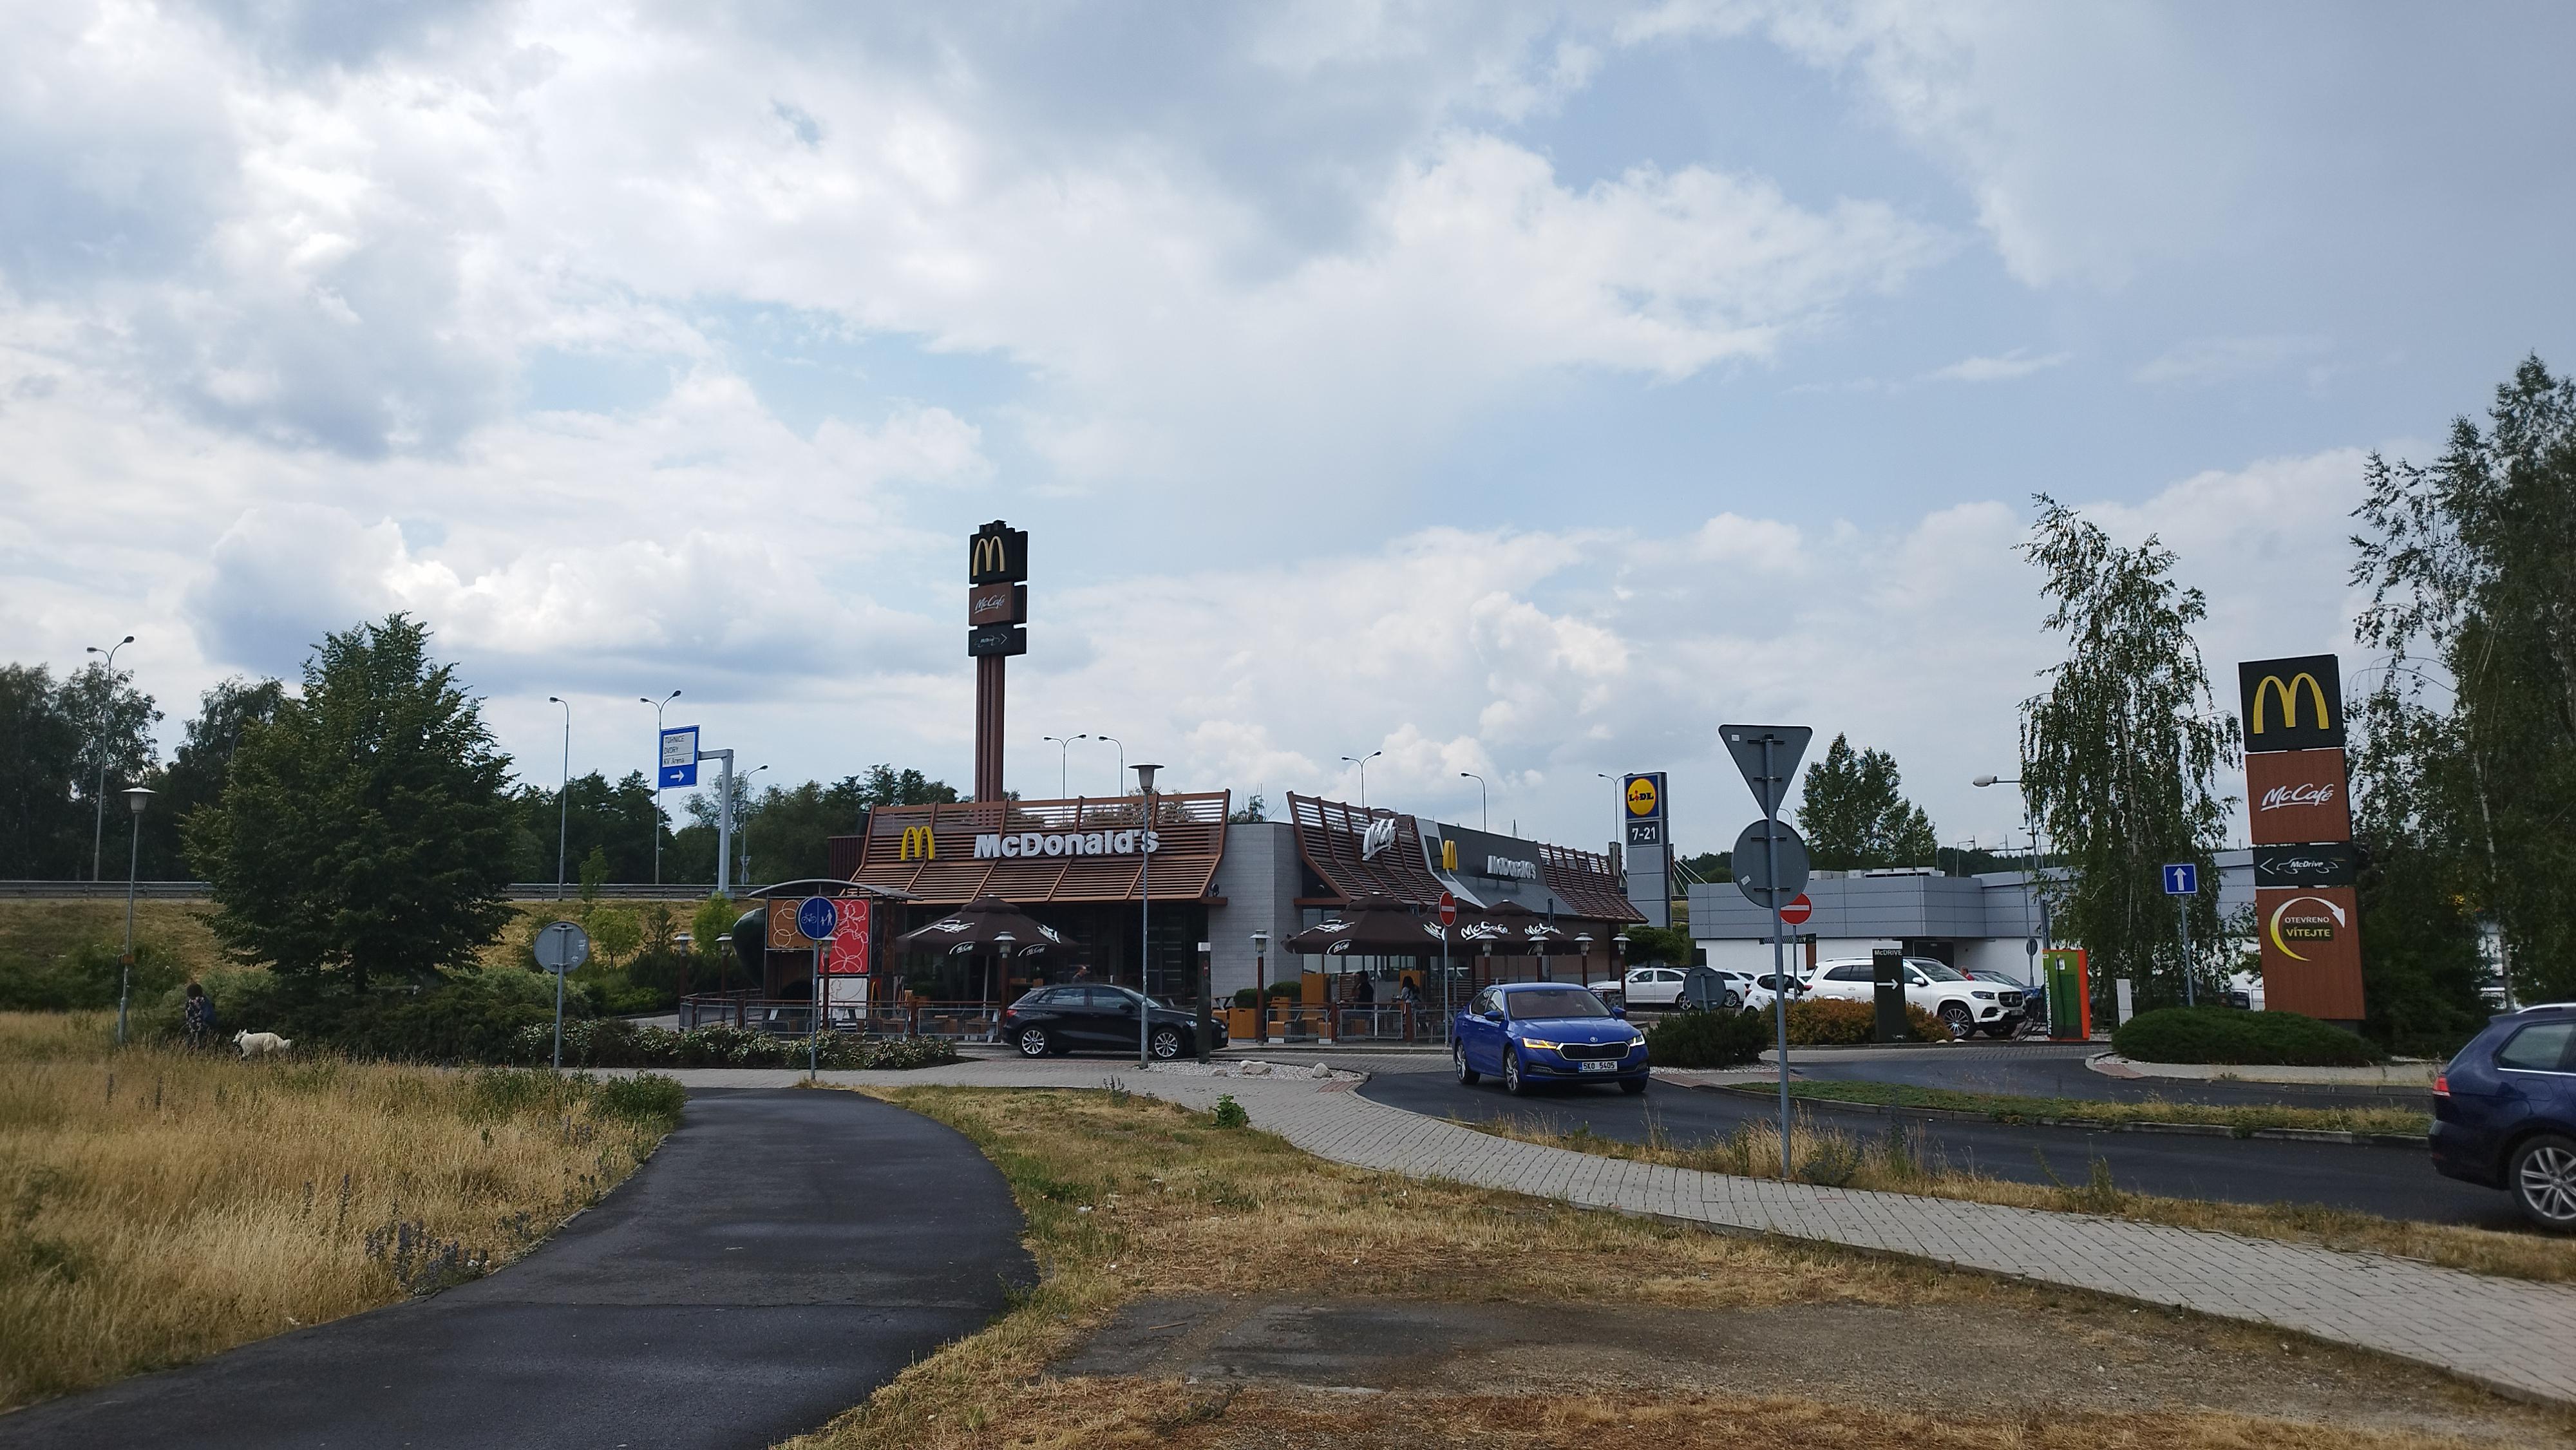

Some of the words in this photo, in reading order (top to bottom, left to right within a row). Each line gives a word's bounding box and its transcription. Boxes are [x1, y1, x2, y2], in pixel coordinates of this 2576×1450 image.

[2260, 783, 2334, 811] McCafé
[974, 829, 1159, 858] McDonald's
[1632, 827, 1656, 840] 7-21
[2290, 860, 2324, 869] McDrive
